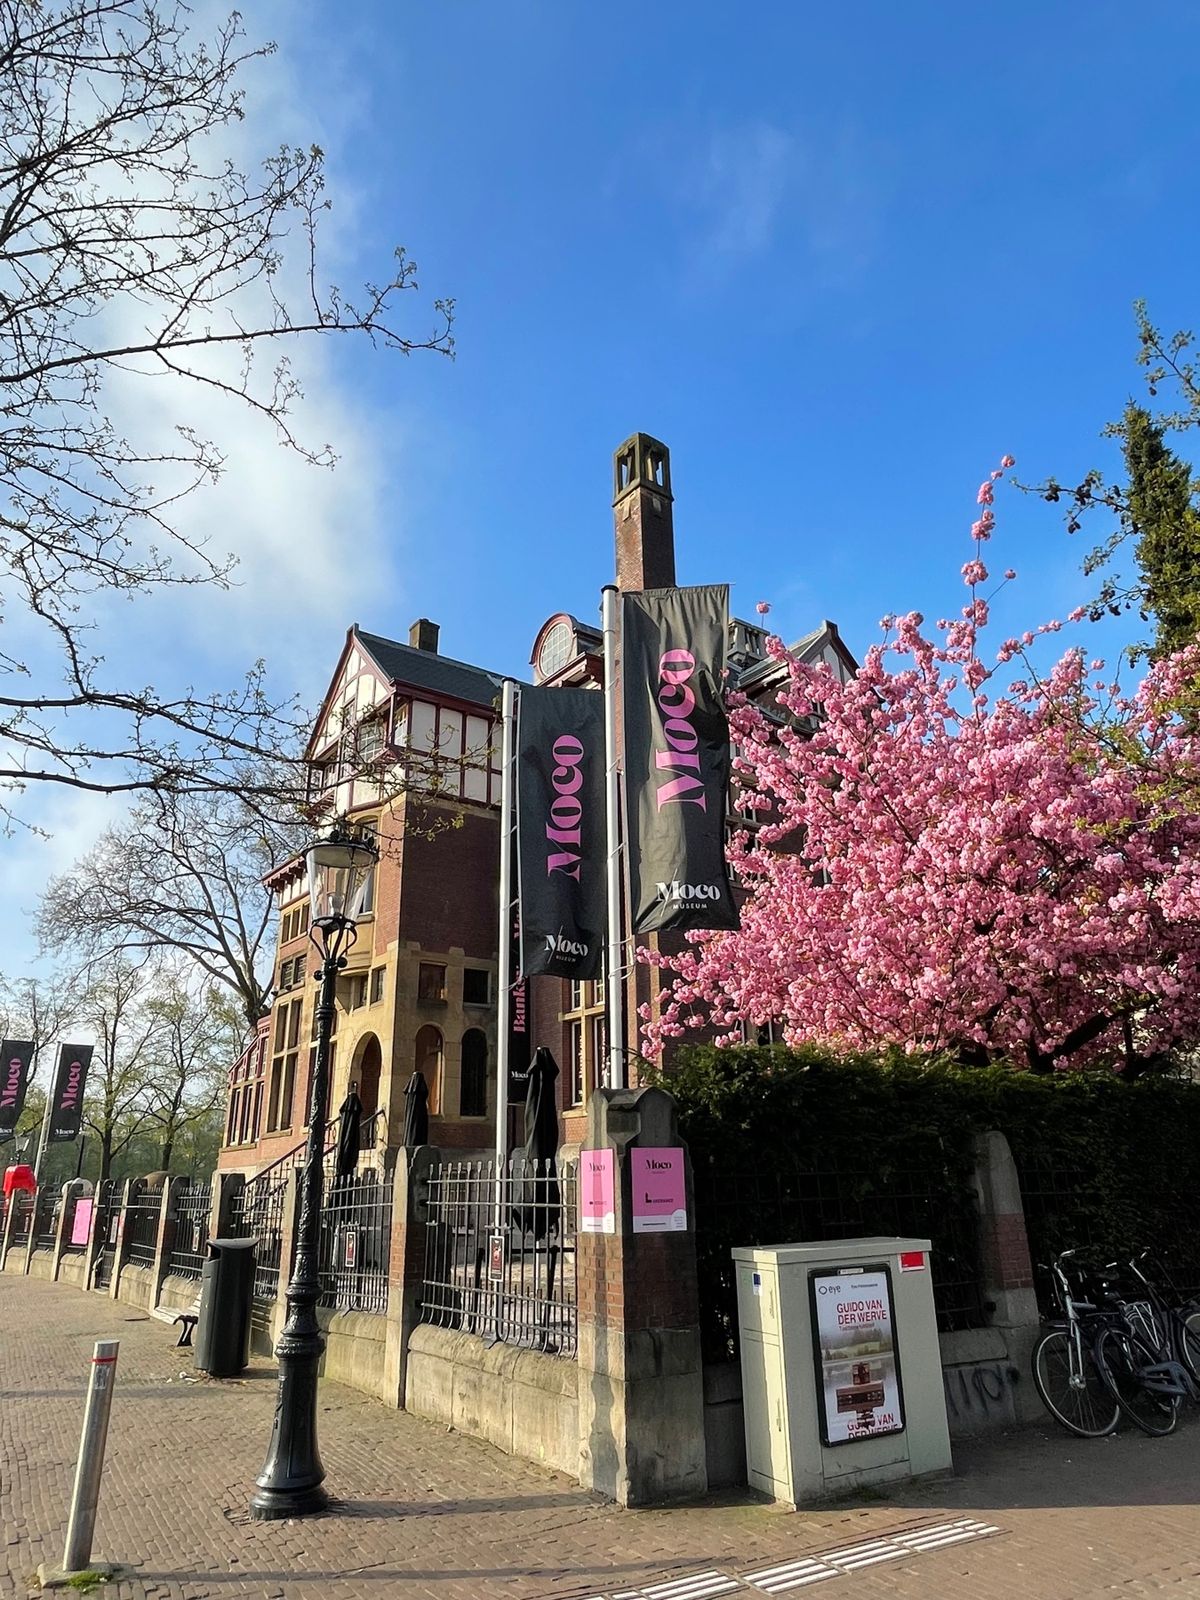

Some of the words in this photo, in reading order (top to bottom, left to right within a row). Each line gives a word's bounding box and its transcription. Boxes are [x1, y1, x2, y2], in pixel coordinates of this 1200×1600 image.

[654, 647, 707, 814] Moco
[545, 734, 584, 884] Moco
[655, 872, 720, 908] Moco
[544, 929, 588, 959] Moco
[0, 1058, 21, 1108] Moco
[60, 1061, 81, 1110] Moco
[645, 1159, 672, 1169] Moco
[837, 1301, 864, 1314] GUIDO
[865, 1300, 882, 1311] VAN
[838, 1313, 857, 1325] DER
[857, 1310, 887, 1322] WERVE
[877, 1412, 894, 1425] VAN
